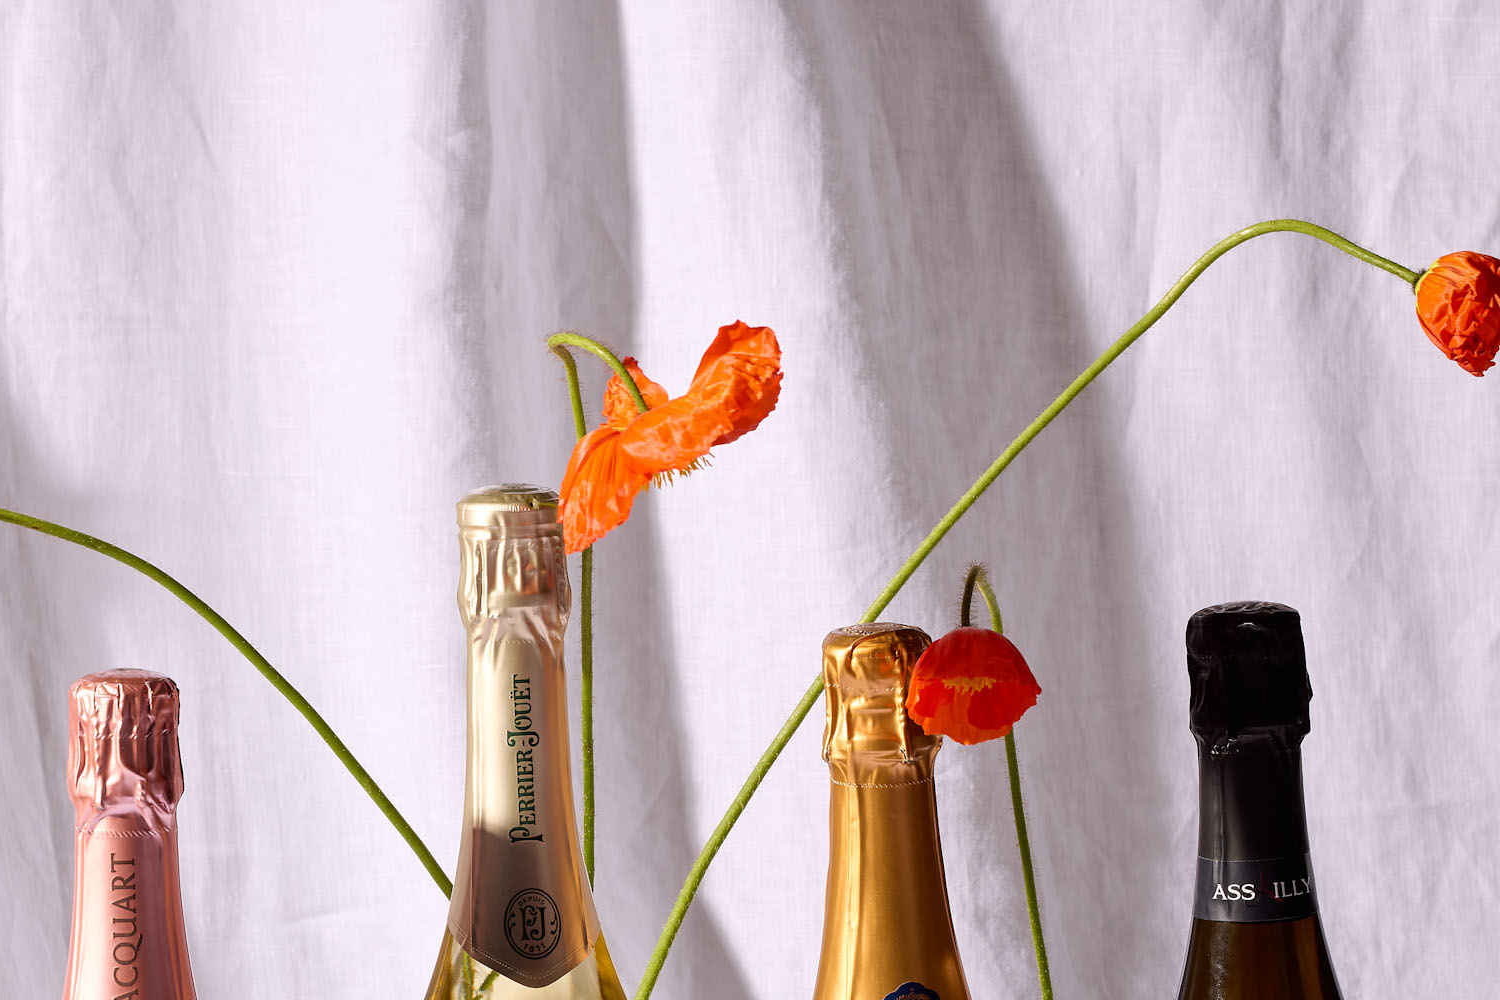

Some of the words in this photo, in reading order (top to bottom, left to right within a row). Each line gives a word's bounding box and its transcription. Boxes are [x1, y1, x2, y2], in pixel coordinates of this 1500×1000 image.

[507, 673, 544, 845] PERRIER-JOUËT
[517, 895, 546, 907] DEPUIS
[523, 941, 547, 953] 1811
